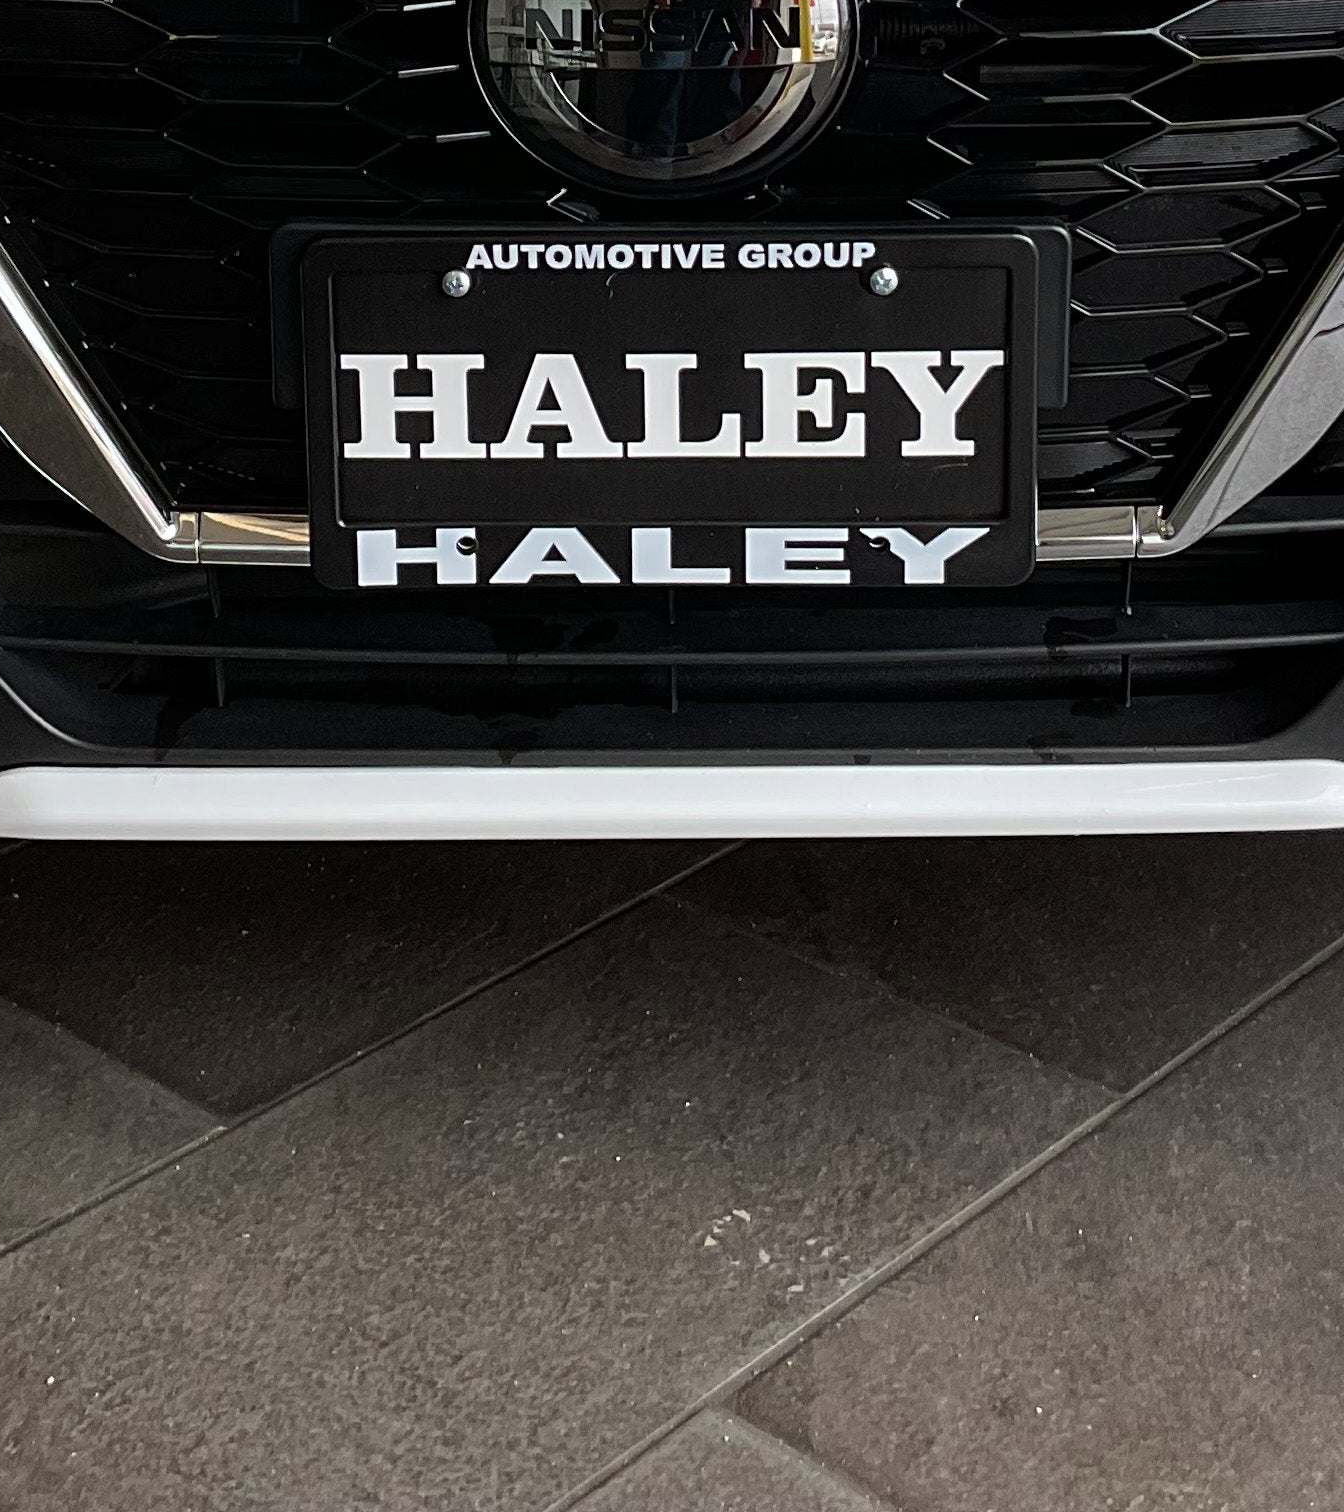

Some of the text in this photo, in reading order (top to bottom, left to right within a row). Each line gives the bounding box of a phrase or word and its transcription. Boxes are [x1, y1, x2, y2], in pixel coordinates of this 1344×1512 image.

[525, 7, 802, 52] NISSAN
[465, 241, 876, 270] AUTOMOTIVE GROUP
[339, 349, 1005, 459] HALEY
[356, 527, 991, 587] HALEY
